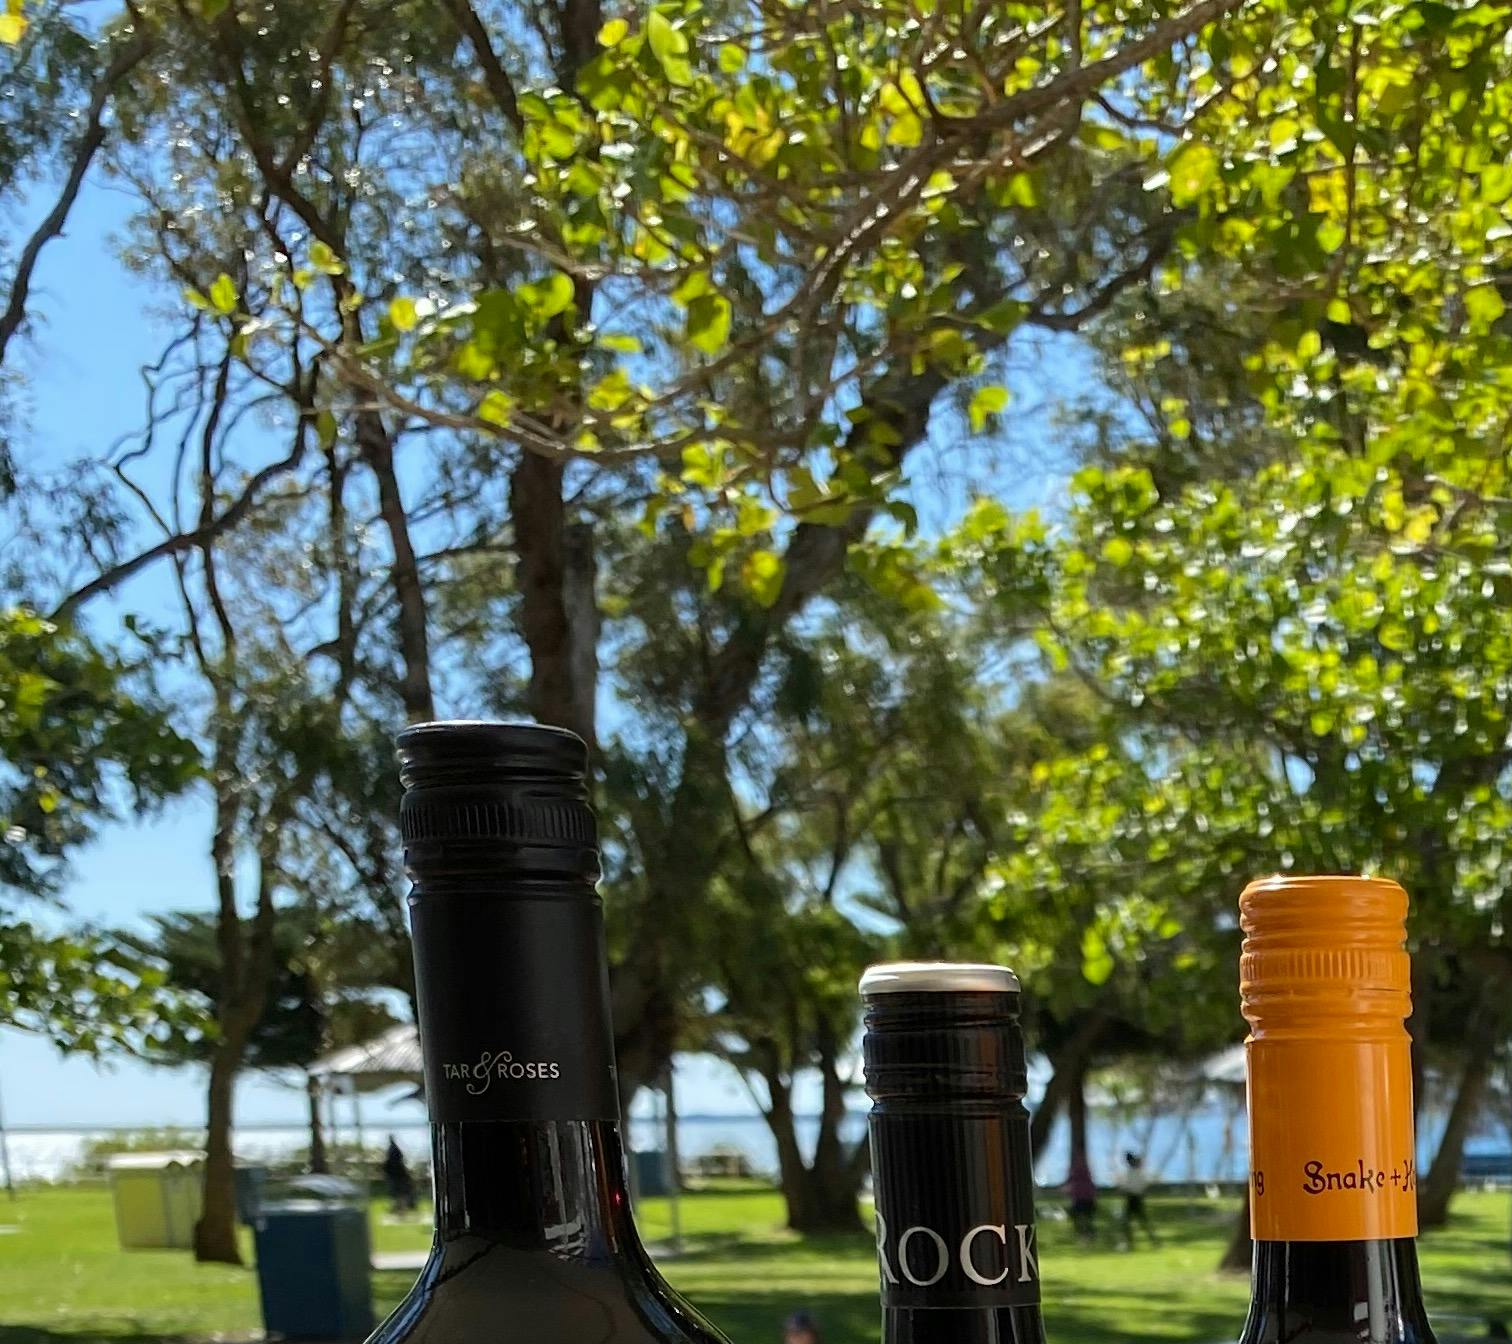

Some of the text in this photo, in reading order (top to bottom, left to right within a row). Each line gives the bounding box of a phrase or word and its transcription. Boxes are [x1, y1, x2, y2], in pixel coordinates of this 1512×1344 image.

[442, 1063, 471, 1080] TAR
[498, 1062, 561, 1080] ROSES
[1302, 1159, 1386, 1195] Snake
